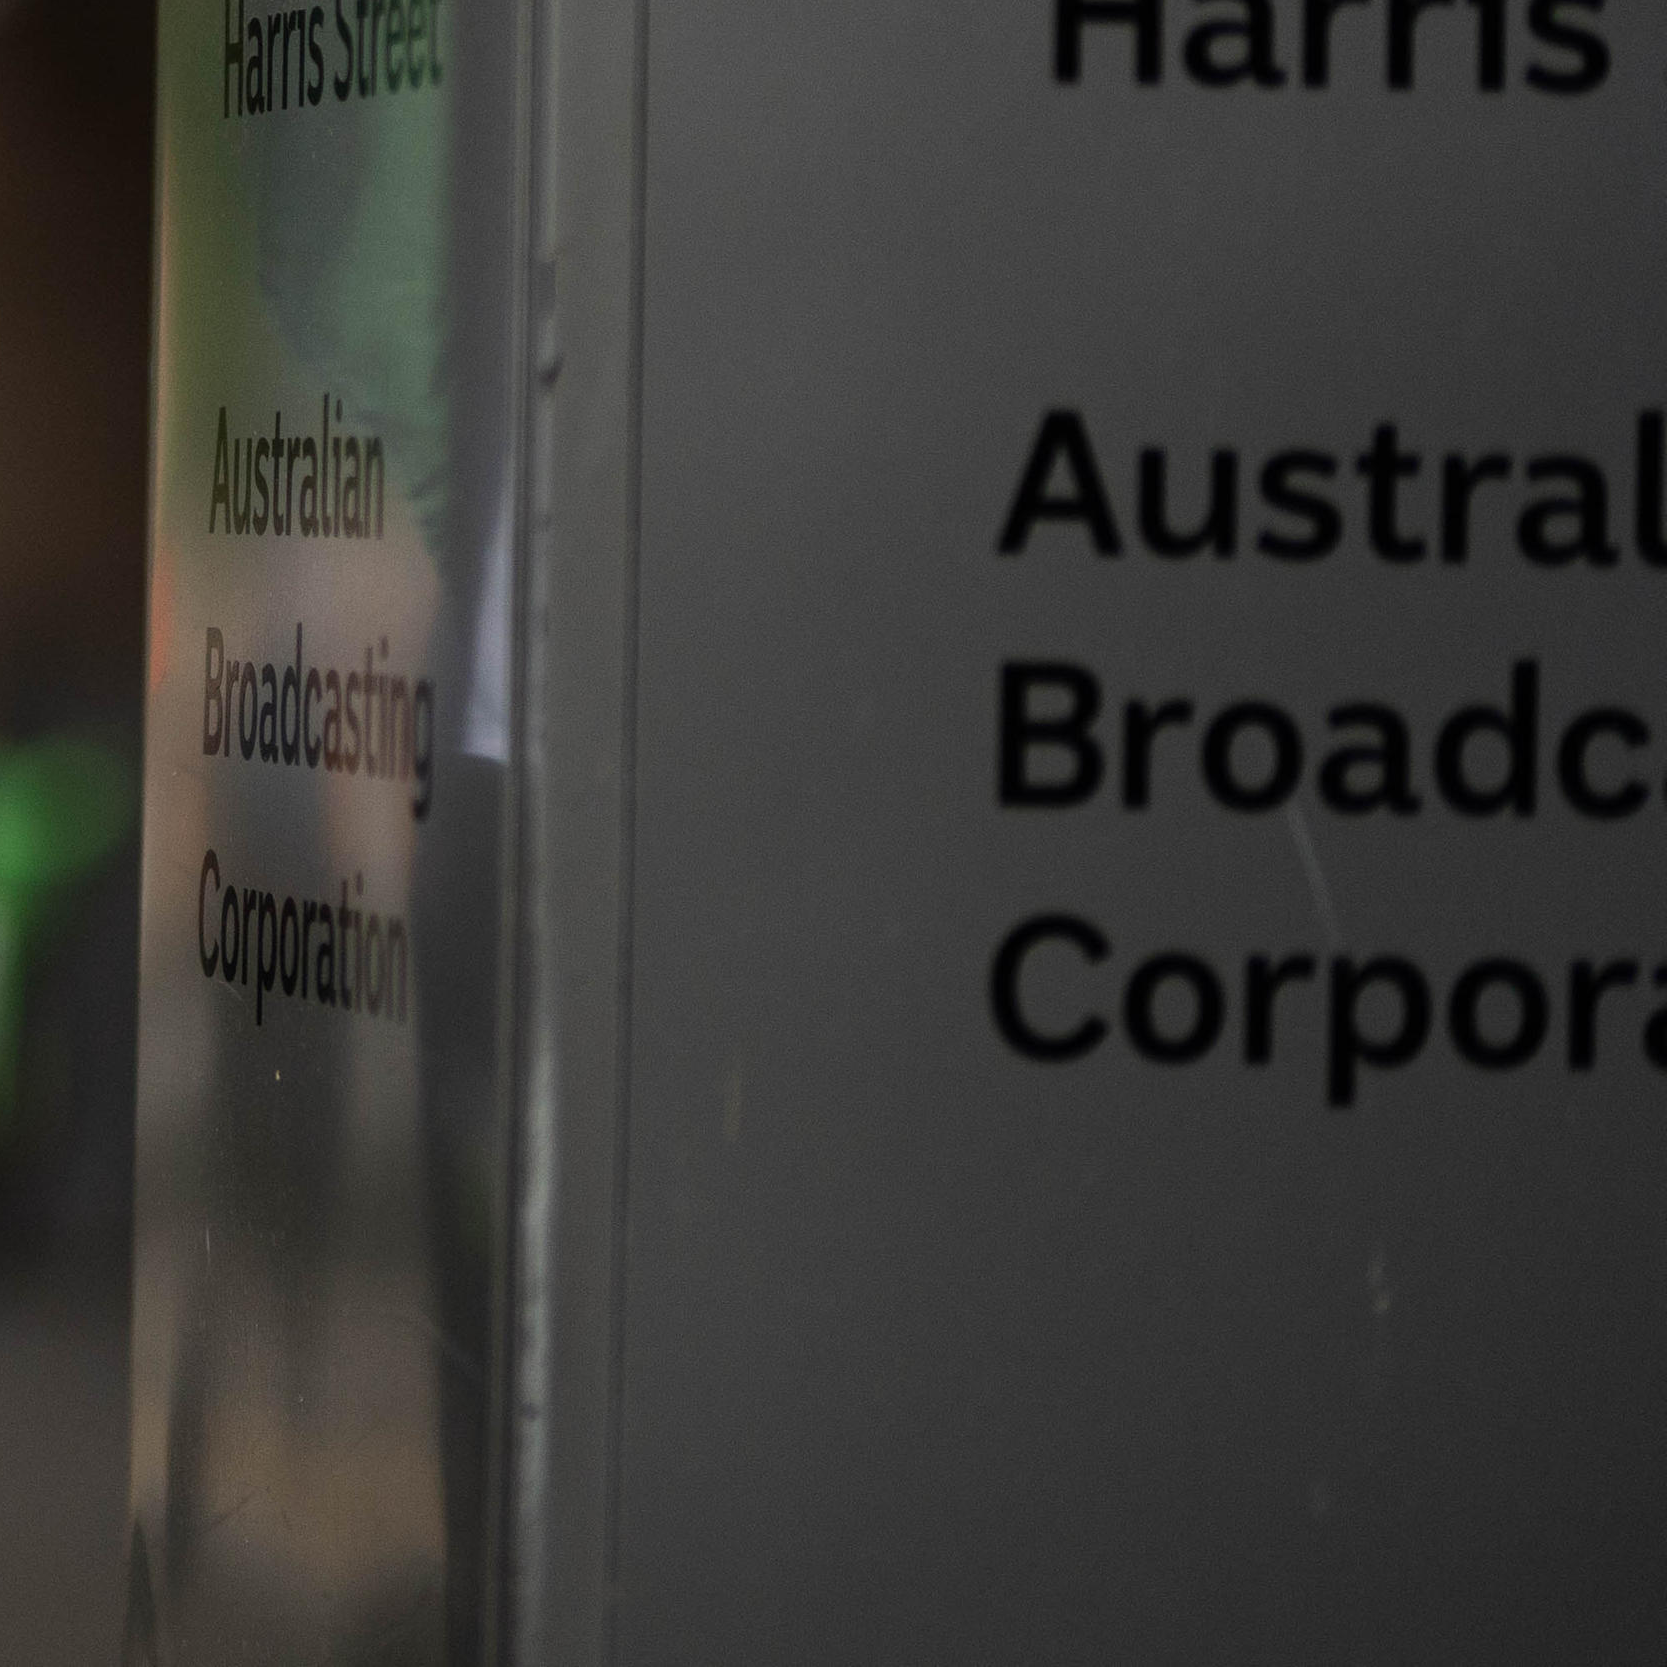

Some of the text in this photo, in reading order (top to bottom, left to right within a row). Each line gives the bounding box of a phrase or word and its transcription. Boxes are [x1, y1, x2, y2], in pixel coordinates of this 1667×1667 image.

[208, 391, 386, 541] Australian
[202, 622, 435, 822] Broadcasting
[997, 658, 1667, 821] Broadc
[198, 848, 411, 1027] Corporation
[988, 912, 1667, 1110] Corpor
